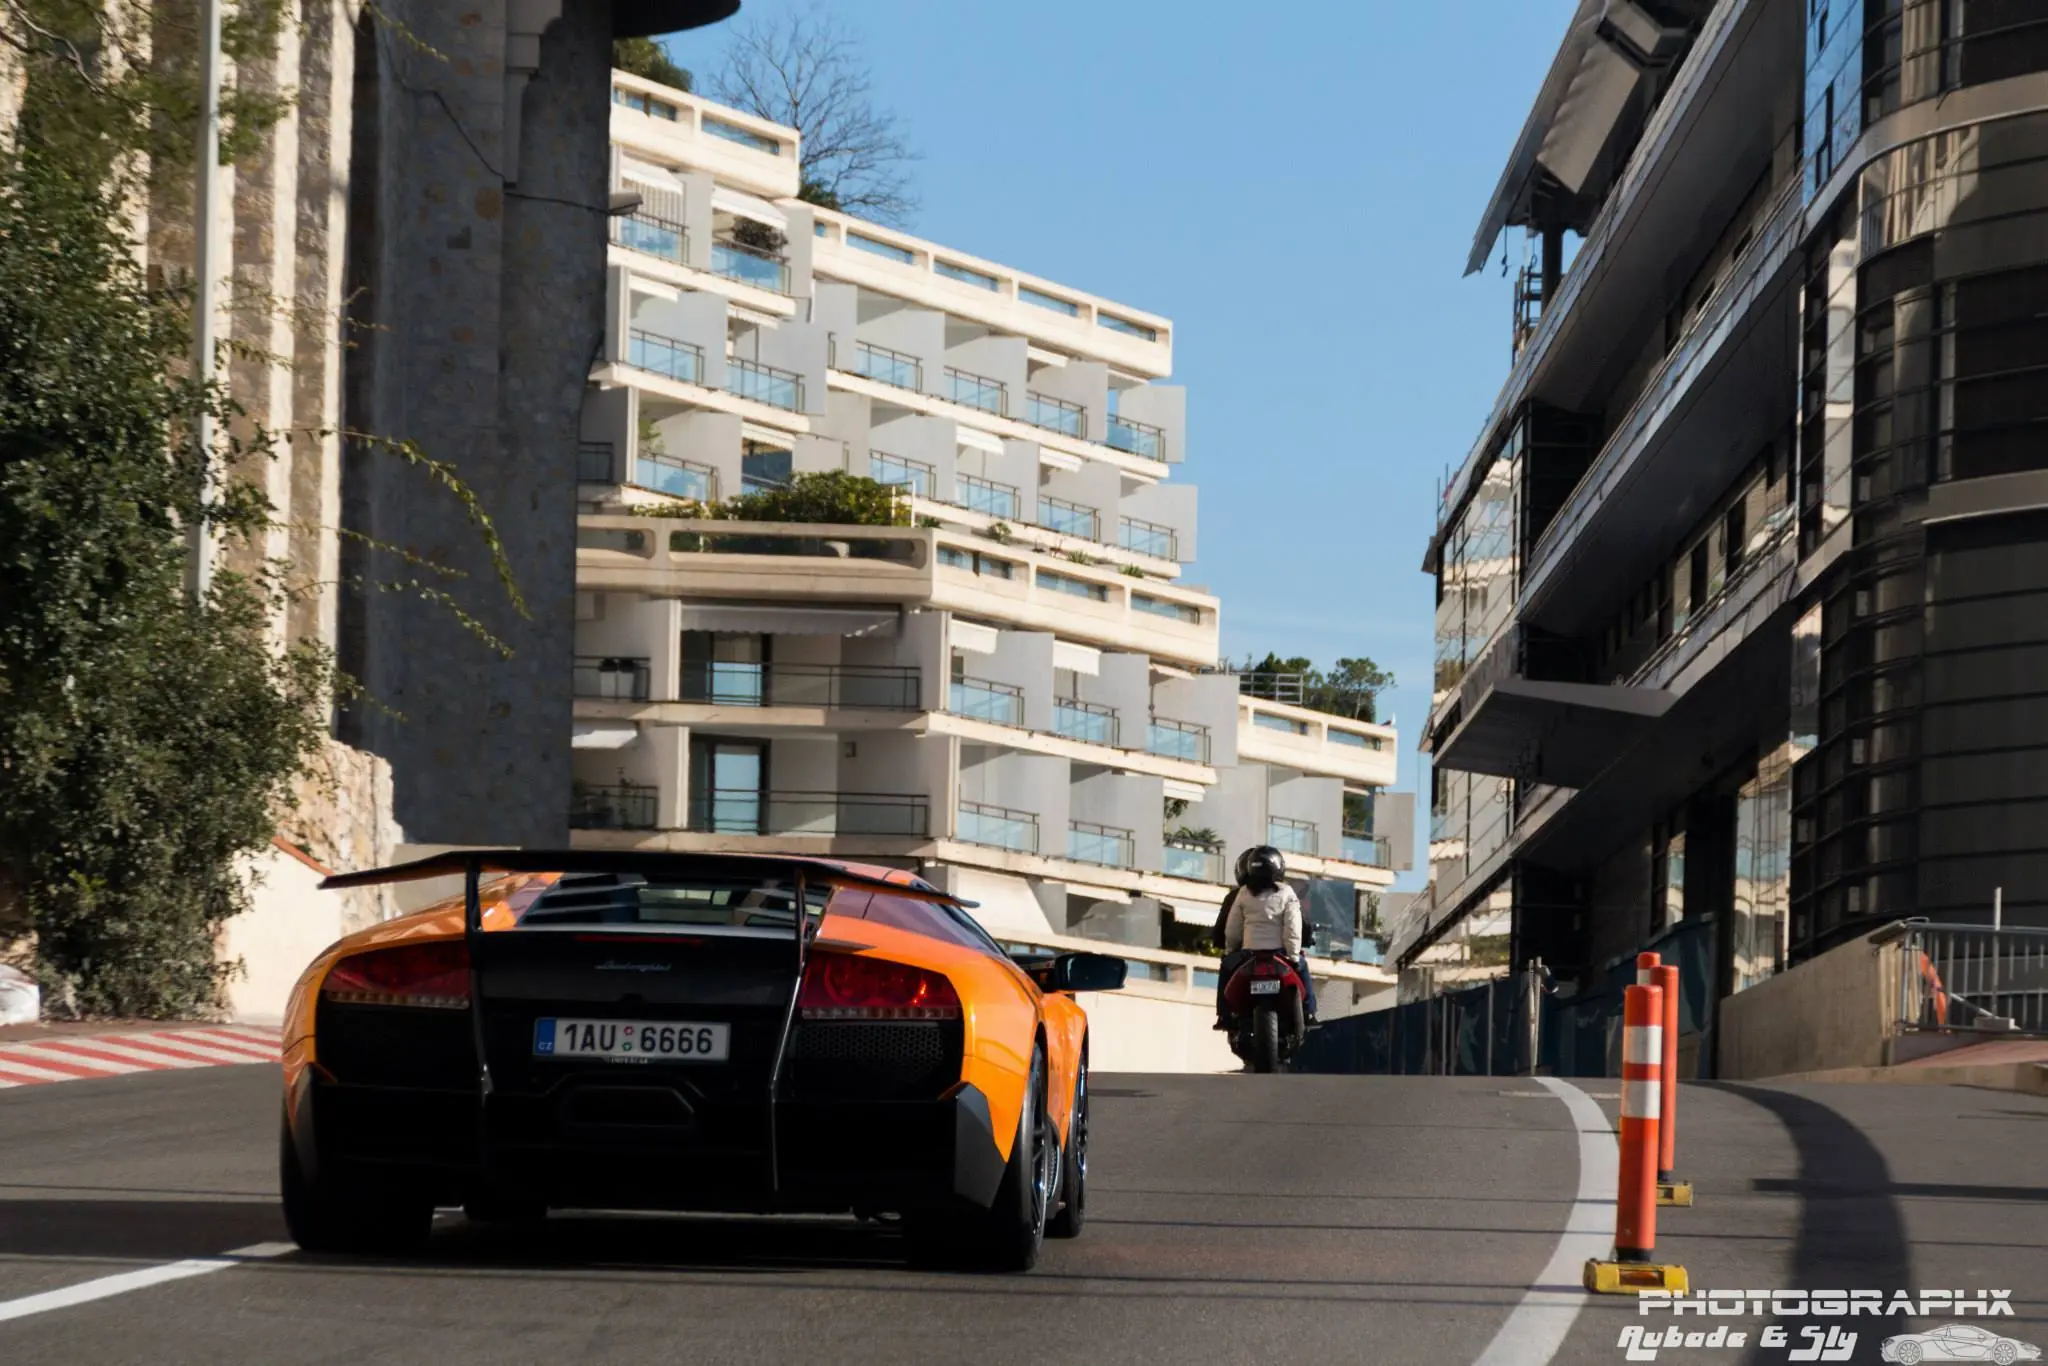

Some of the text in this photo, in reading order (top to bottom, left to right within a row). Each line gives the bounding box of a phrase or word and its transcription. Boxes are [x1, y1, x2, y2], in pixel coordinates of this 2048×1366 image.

[537, 1023, 714, 1055] CZ 1AU 6666
